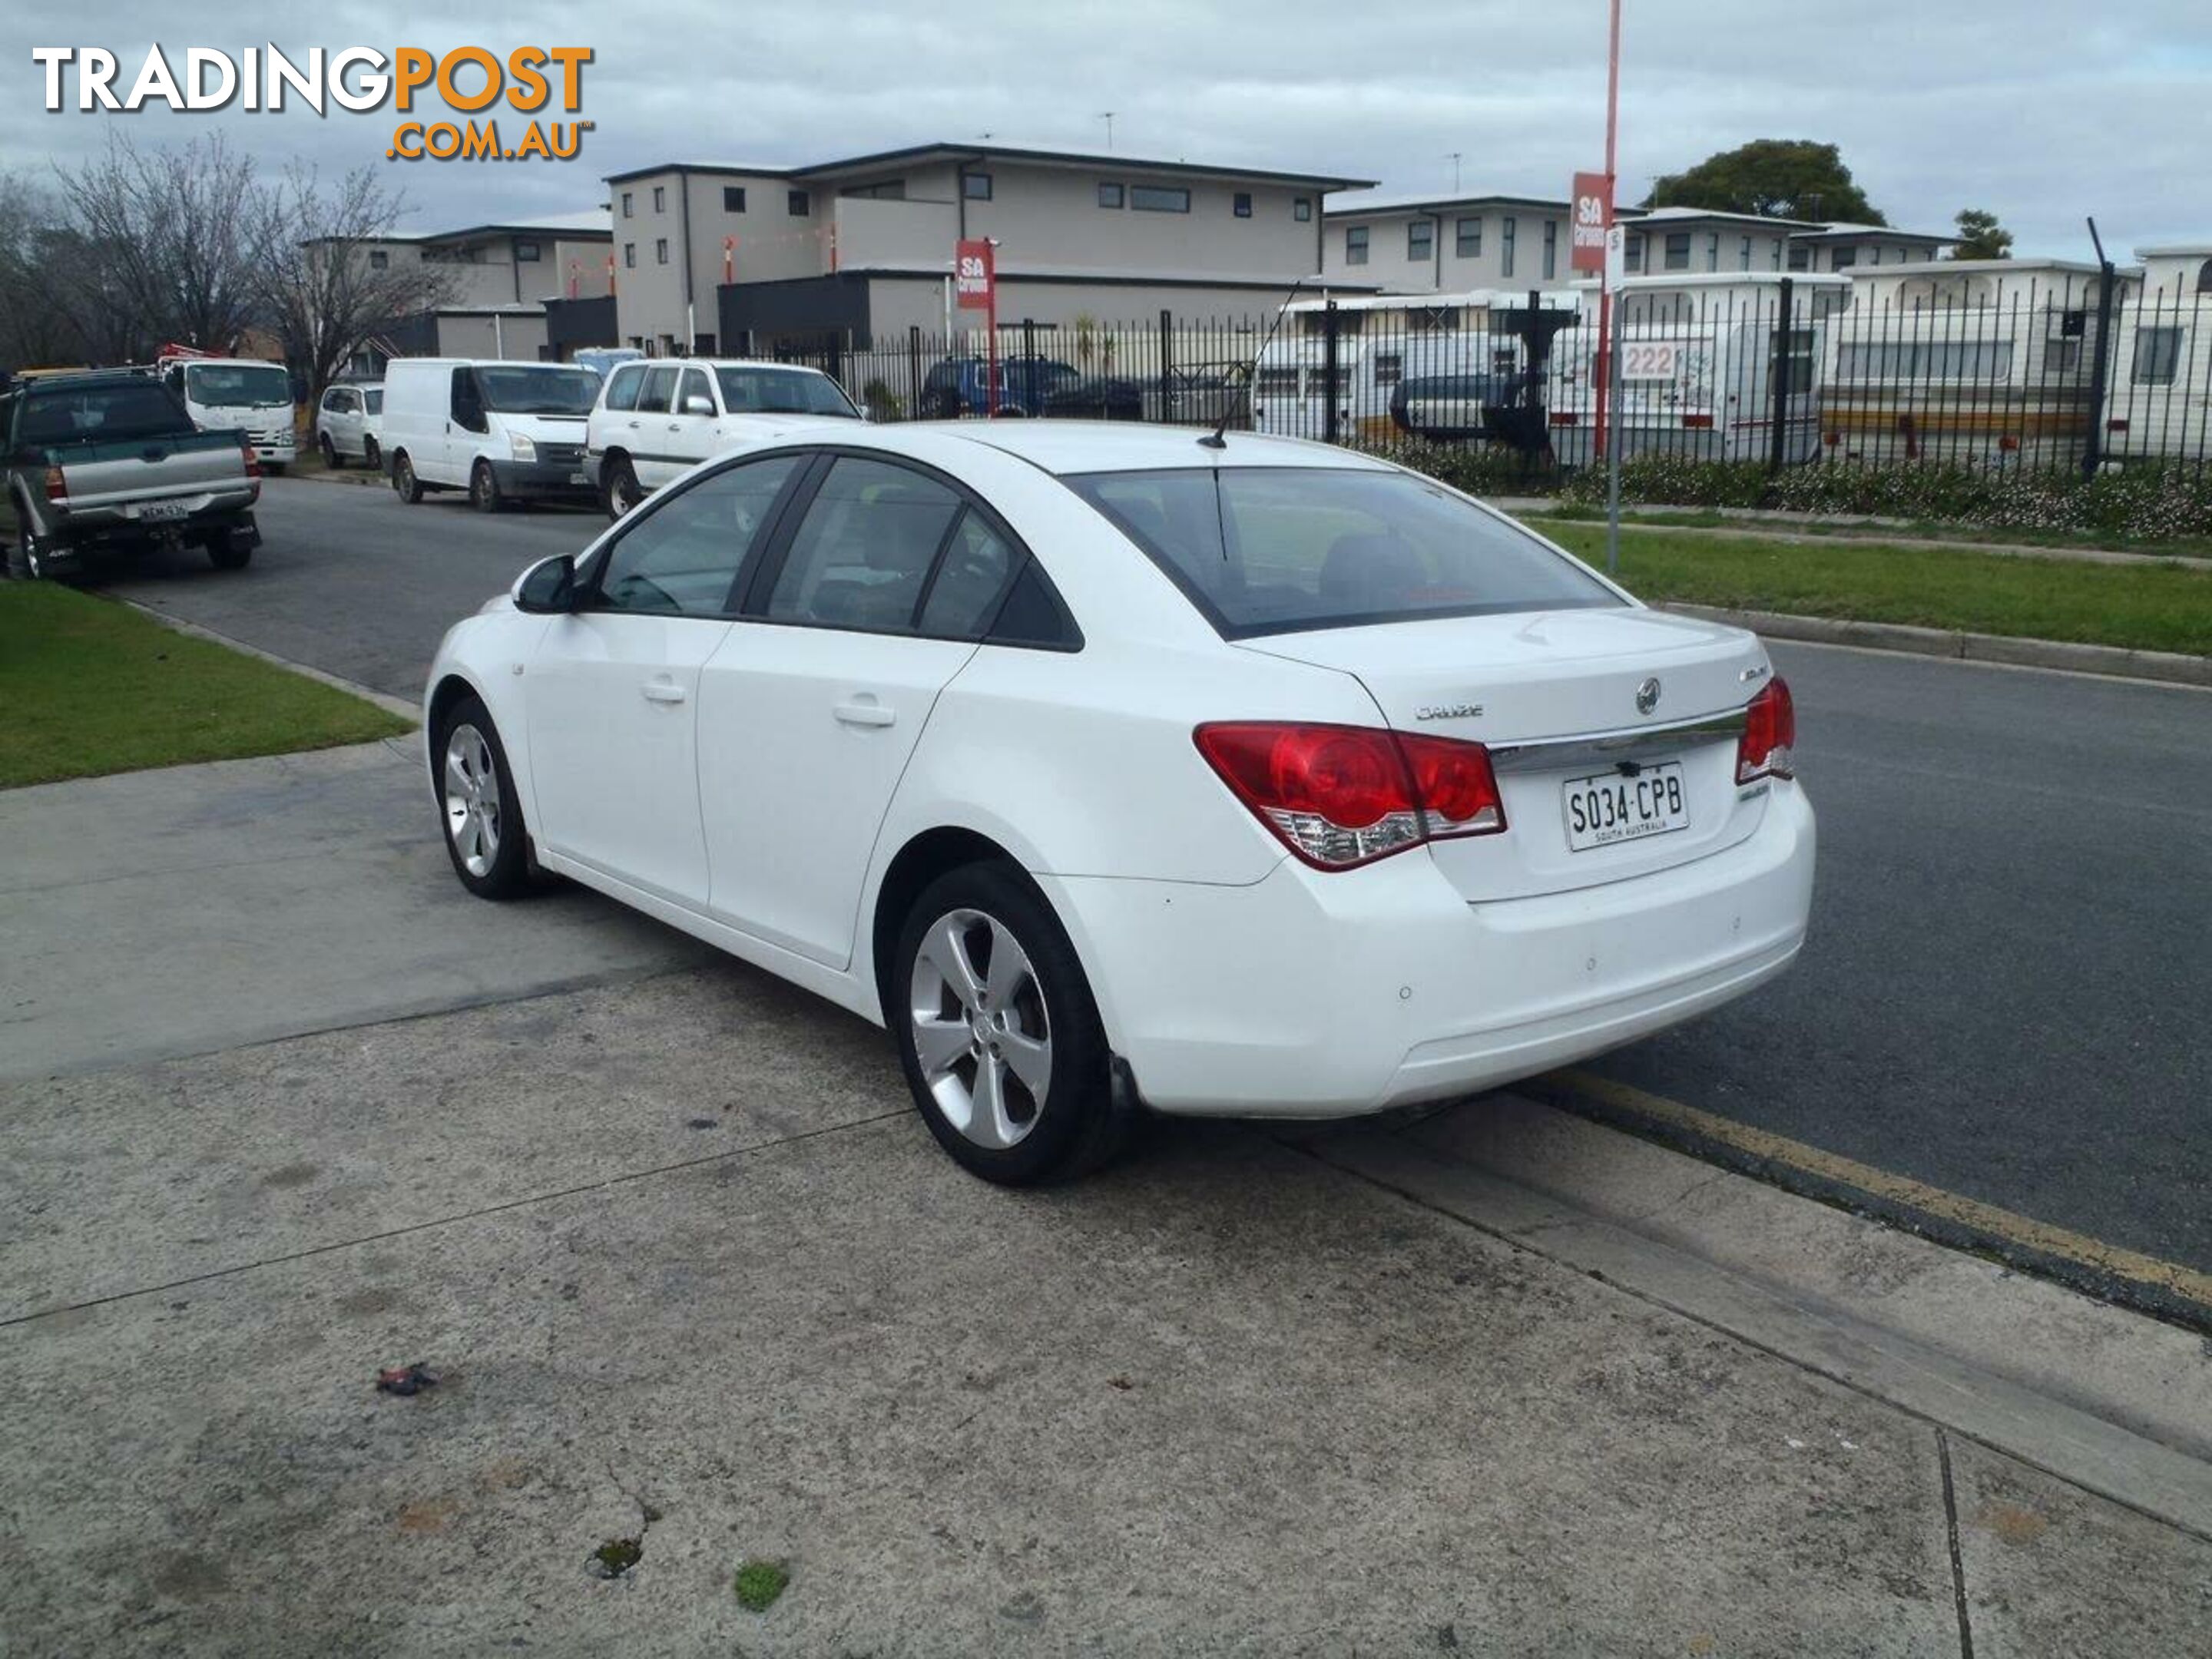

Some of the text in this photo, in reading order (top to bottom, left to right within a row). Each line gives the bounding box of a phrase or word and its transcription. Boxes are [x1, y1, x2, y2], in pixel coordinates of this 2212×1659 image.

[1578, 196, 1603, 223] SA
[961, 257, 984, 277] SA
[1626, 347, 1672, 374] 222
[1596, 820, 1667, 842] SOUTH AUSTRALIA
